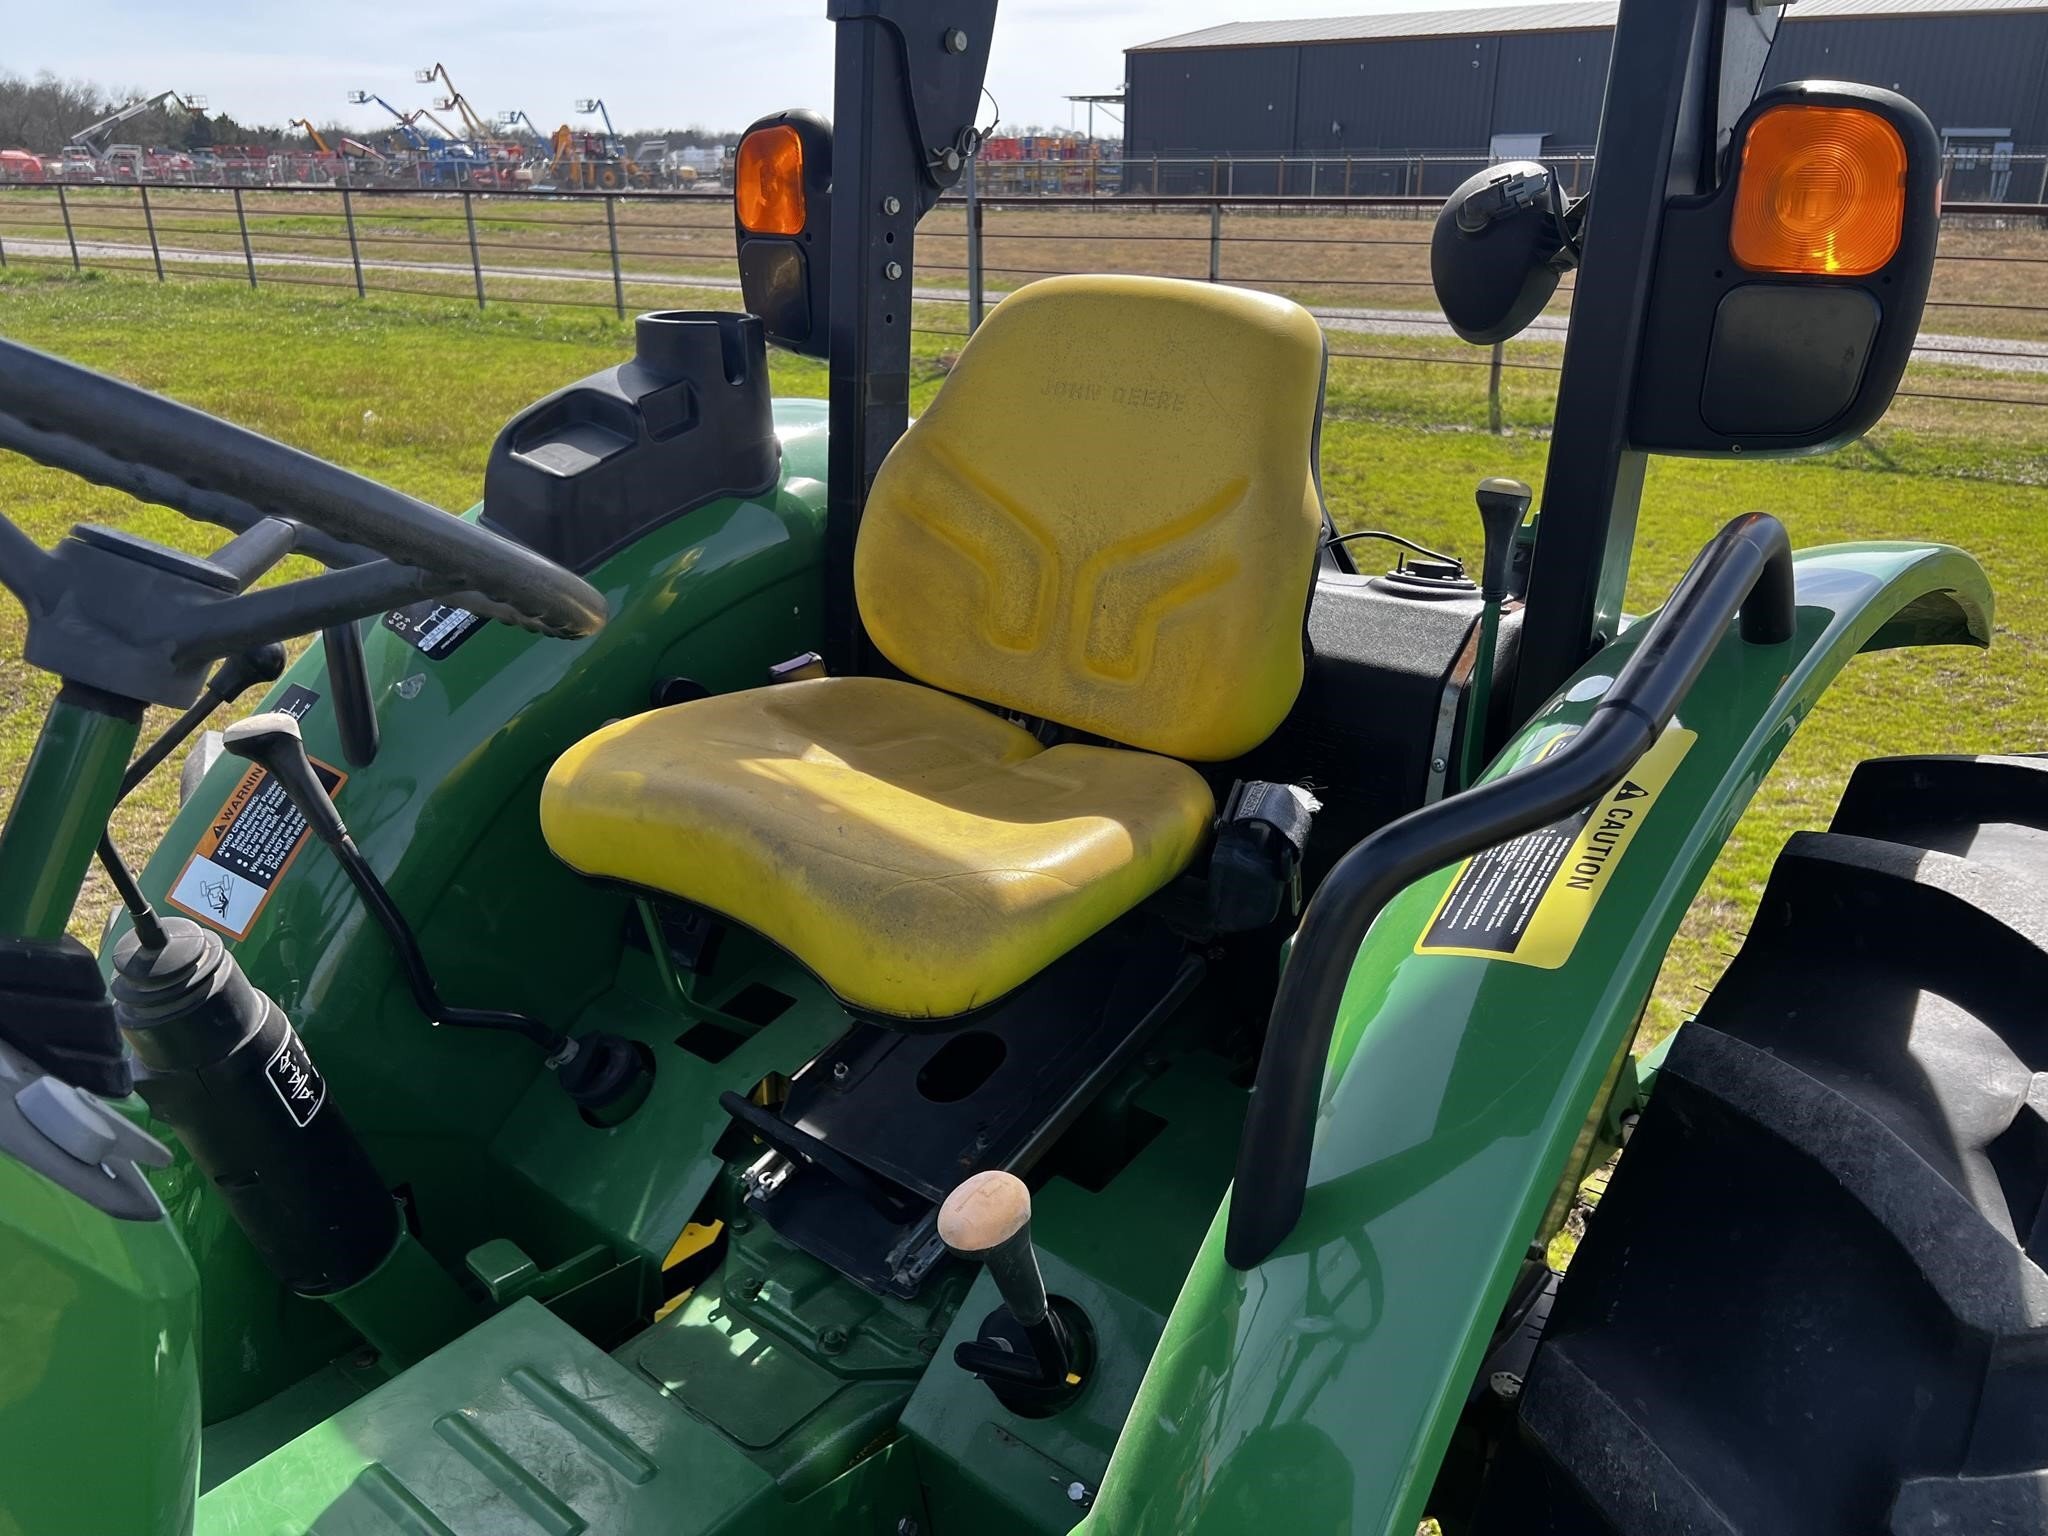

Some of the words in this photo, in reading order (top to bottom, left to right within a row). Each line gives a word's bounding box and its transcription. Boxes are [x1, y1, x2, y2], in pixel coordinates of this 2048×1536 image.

[1041, 380, 1101, 401] JOHN
[1111, 385, 1185, 412] DEERE
[222, 767, 263, 820] WARNIN
[230, 831, 245, 848] Keep
[242, 802, 263, 830] Rollover
[261, 780, 278, 802] Protec
[236, 820, 260, 852] Structure
[257, 804, 270, 820] fully
[268, 786, 283, 804] exten
[217, 833, 234, 856] AVOID
[232, 794, 260, 833] CRUSHING:
[242, 844, 252, 855] Do
[250, 832, 260, 844] not
[257, 814, 272, 832] jump
[248, 844, 260, 858] Use
[258, 828, 270, 844] seat
[267, 814, 281, 829] belt.
[249, 853, 266, 872] When
[264, 822, 285, 853] structure
[264, 854, 274, 866] DO
[271, 837, 284, 854] NOT
[283, 825, 293, 838] use
[292, 812, 302, 825] sea
[1566, 808, 1633, 891] CAUTION
[270, 851, 286, 869] Drive
[283, 836, 295, 850] with
